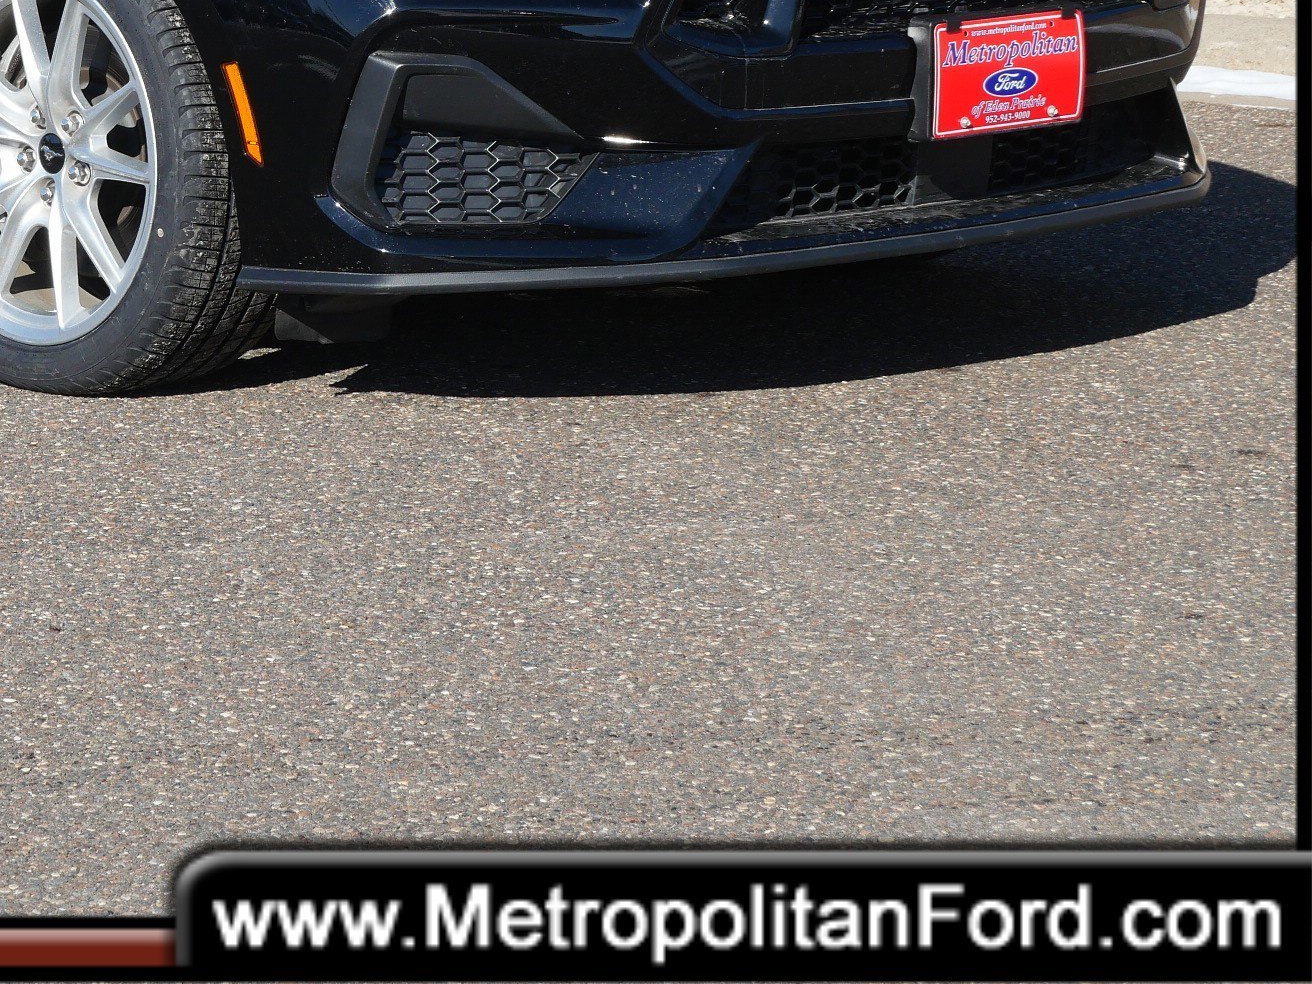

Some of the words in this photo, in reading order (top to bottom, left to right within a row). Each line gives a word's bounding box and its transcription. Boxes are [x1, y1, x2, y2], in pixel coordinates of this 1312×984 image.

[971, 22, 1047, 36] www.metropolitanford.com
[942, 30, 1077, 67] Metropolitan
[994, 72, 1026, 91] Ford
[971, 100, 986, 119] of
[983, 99, 1010, 114] Eden
[1010, 94, 1047, 110] Prairie
[985, 110, 1031, 124] 952-943-9000
